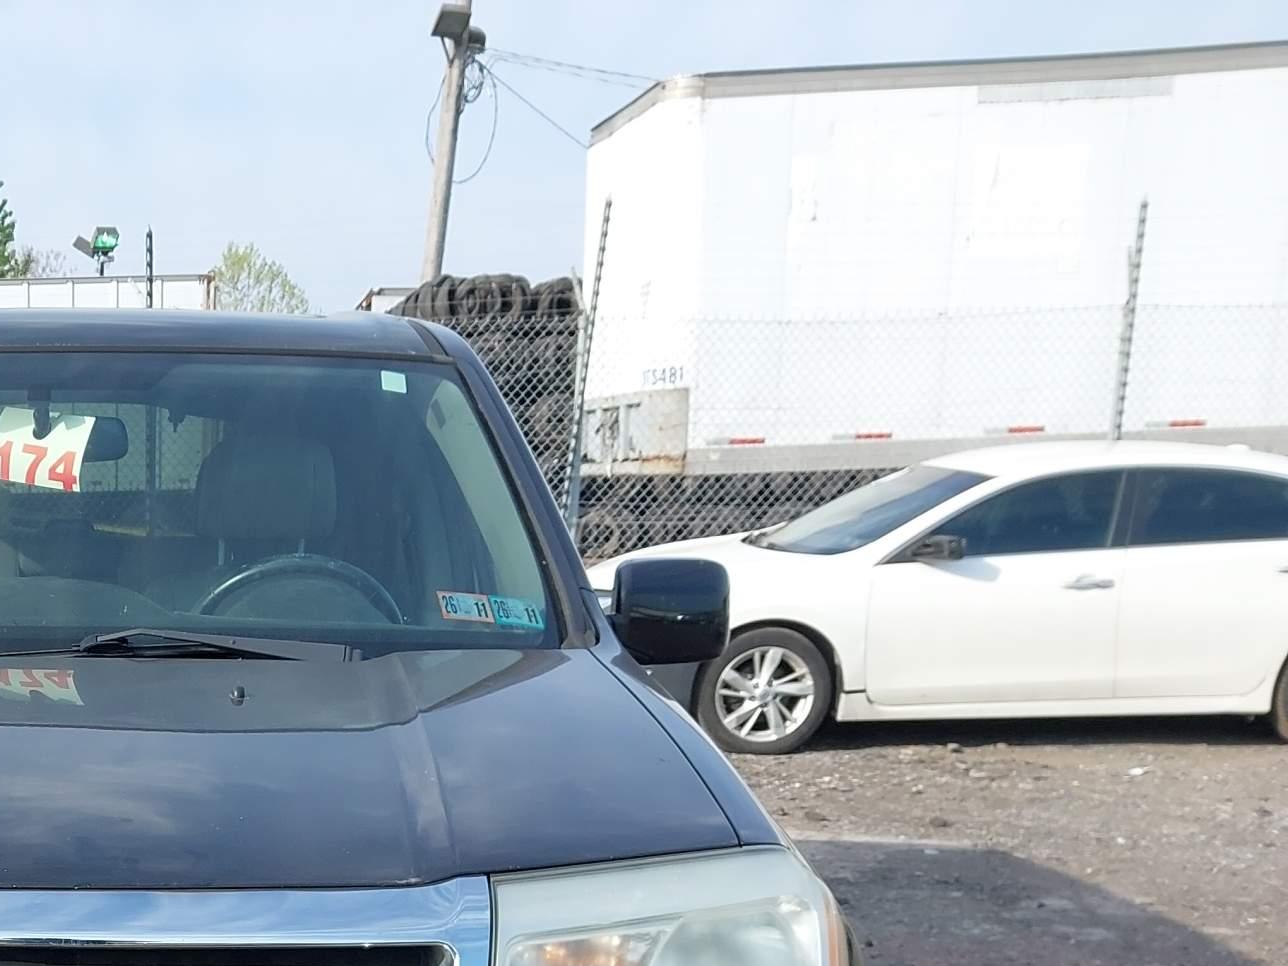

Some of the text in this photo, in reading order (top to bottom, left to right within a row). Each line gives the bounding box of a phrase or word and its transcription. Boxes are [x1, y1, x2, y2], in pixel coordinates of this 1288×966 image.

[442, 595, 489, 618] 26 11
[494, 599, 540, 625] 26 11
